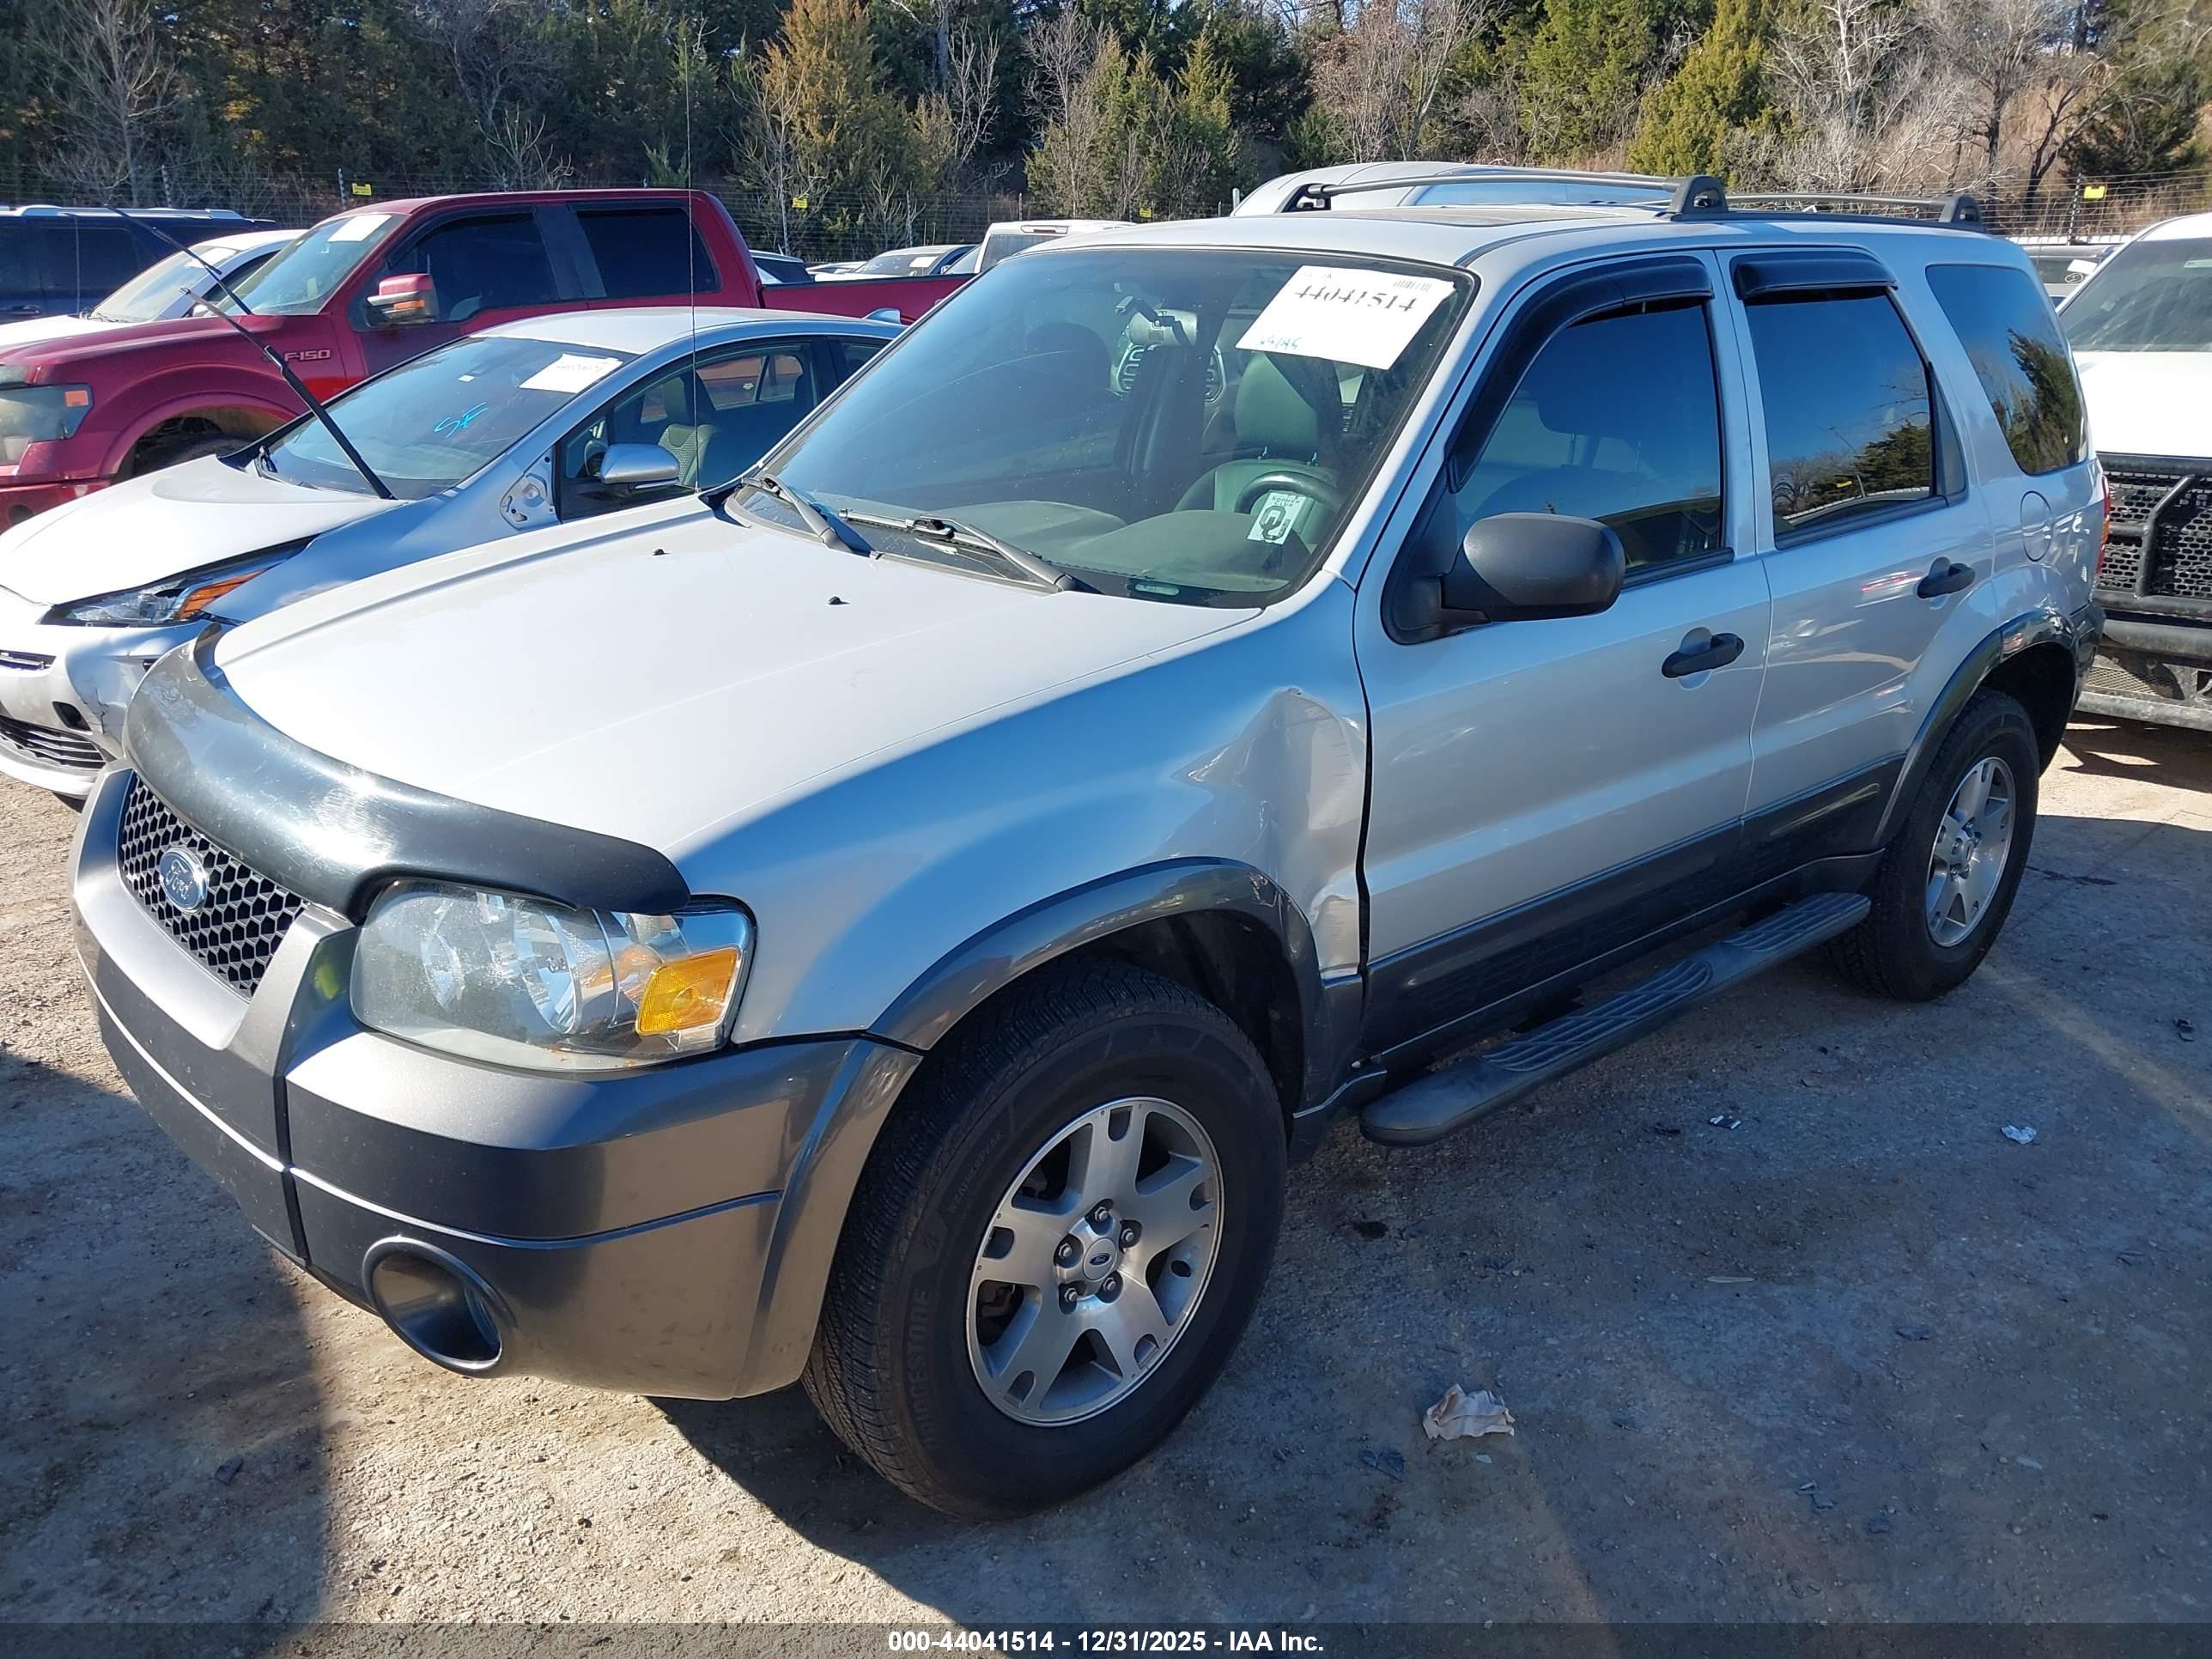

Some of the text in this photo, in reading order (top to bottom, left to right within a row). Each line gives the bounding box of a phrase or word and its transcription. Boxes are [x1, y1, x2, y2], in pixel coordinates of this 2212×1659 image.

[1295, 285, 1417, 312] 44041514
[284, 349, 331, 362] F-150
[166, 860, 194, 900] Ford
